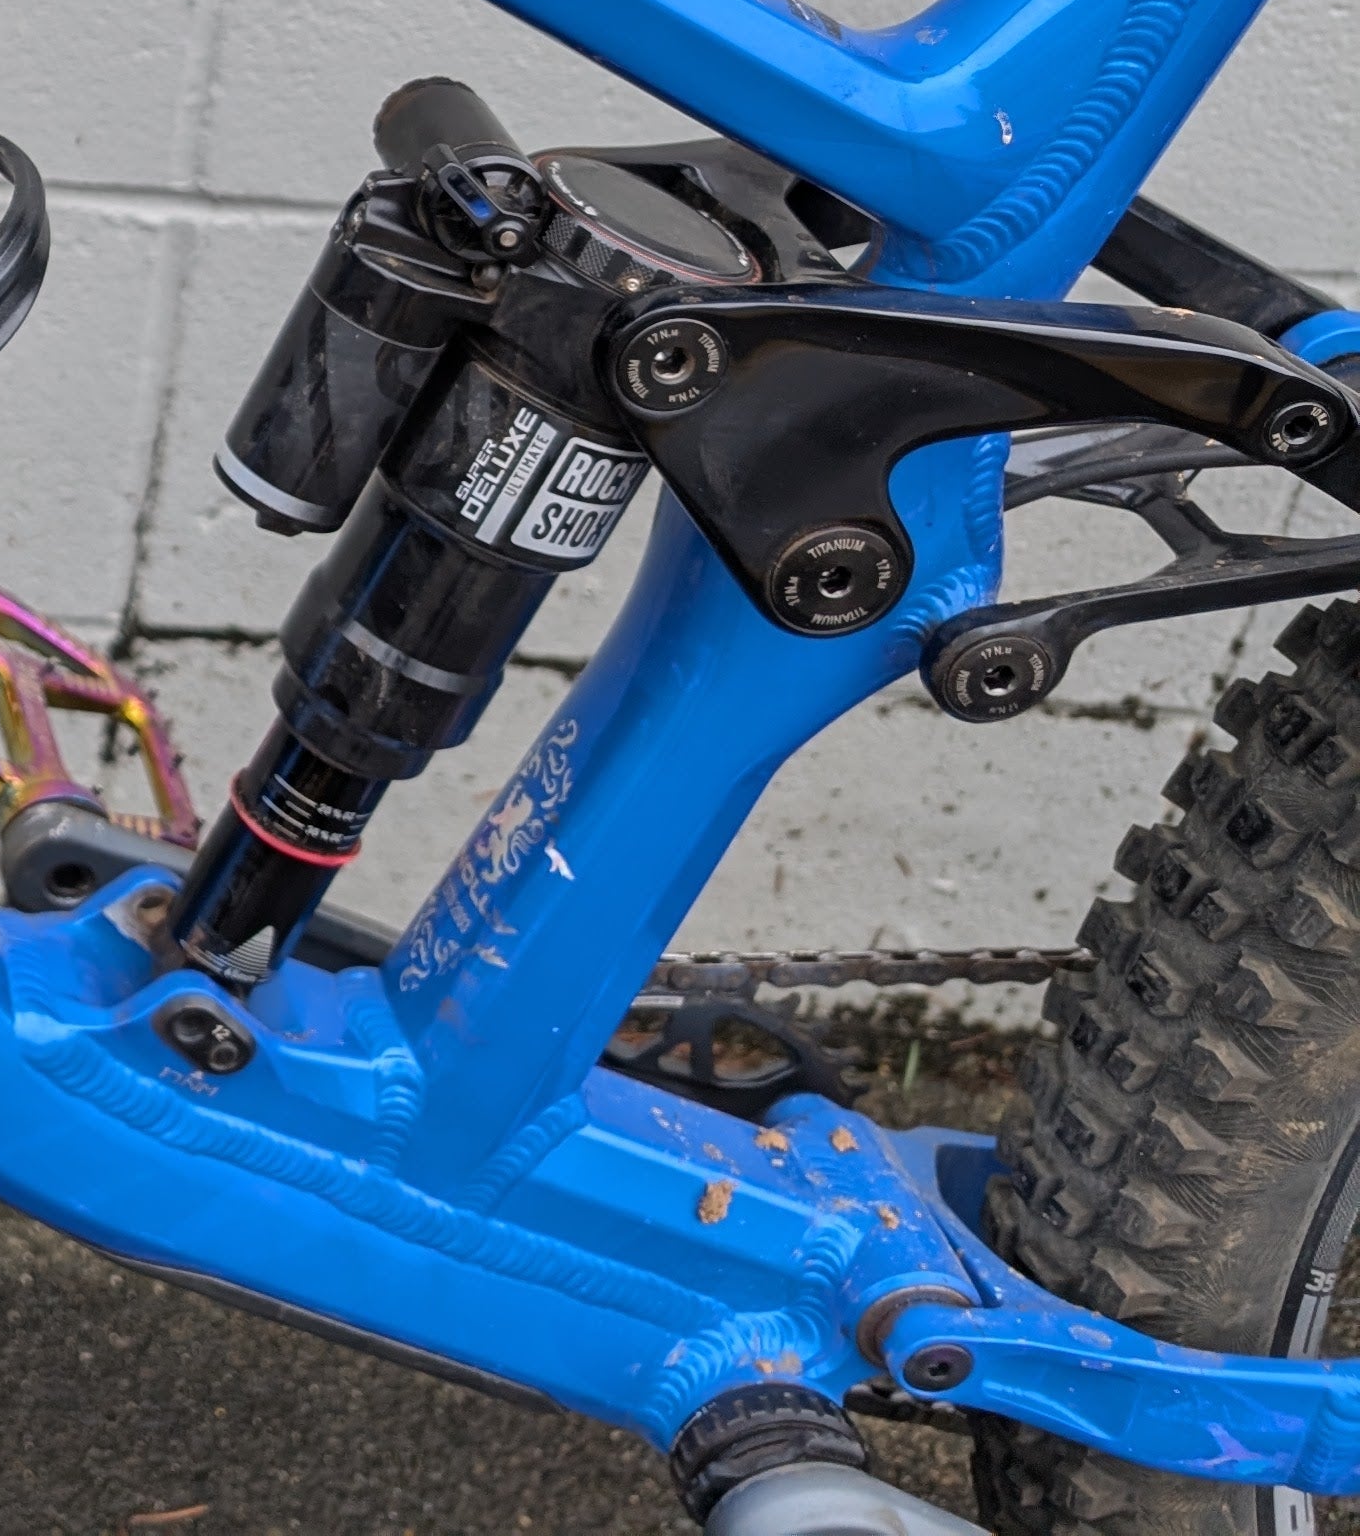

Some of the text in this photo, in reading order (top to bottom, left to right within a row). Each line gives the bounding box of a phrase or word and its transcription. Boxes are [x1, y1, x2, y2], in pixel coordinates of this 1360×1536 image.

[698, 333, 720, 374] TITANIUM
[627, 359, 650, 399] TITANIUM
[455, 438, 497, 502] SUPER
[460, 407, 539, 522] DELUXE
[503, 434, 550, 498] ULTIMATE
[531, 501, 614, 549] SHOX
[806, 538, 866, 559] TITANIUM
[810, 606, 869, 625] TITANIUM
